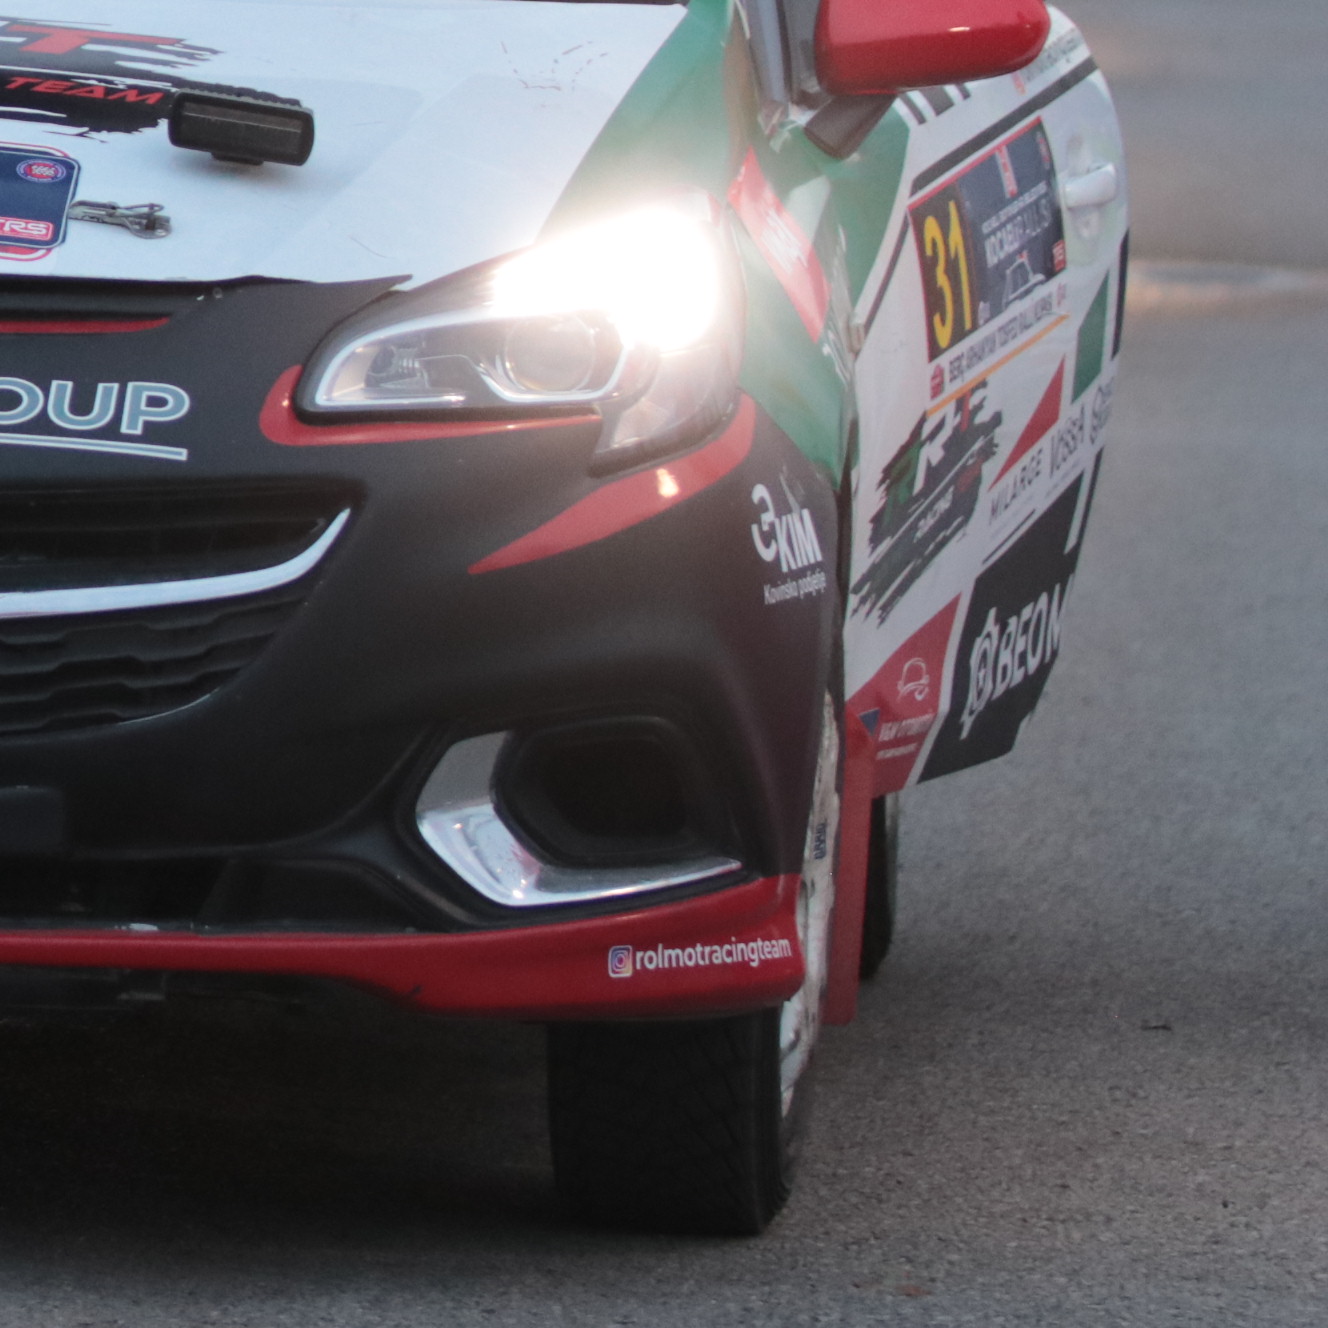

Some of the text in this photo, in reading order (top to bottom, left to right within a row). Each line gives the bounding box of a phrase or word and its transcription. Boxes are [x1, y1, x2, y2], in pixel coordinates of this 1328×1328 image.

[4, 76, 164, 105] TEAM
[923, 199, 973, 350] 31
[635, 937, 793, 970] rolmotracingteam
